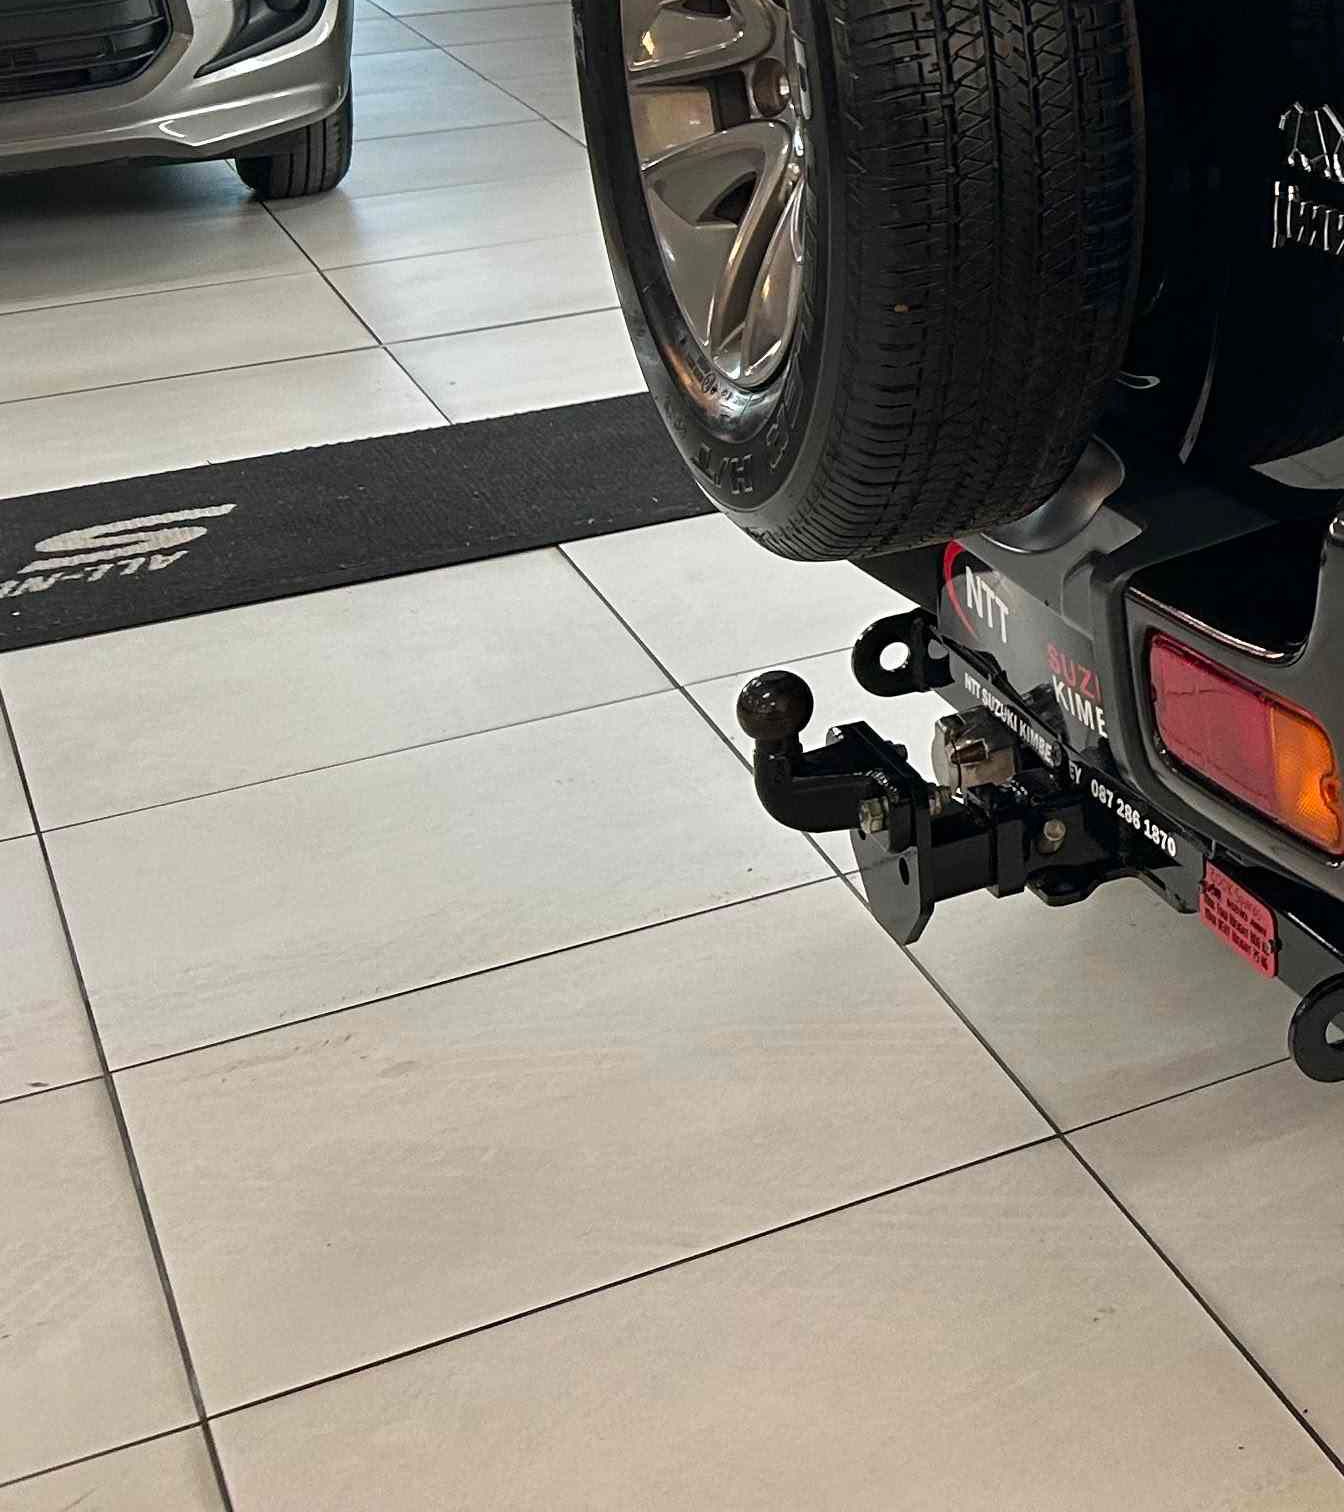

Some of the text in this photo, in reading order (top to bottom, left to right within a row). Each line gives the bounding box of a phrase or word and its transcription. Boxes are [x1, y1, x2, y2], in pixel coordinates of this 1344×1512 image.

[964, 565, 1010, 644] NTT
[964, 672, 981, 699] NTT
[981, 688, 1018, 733] SUZUKI
[1091, 779, 1114, 808] 087
[1144, 819, 1176, 857] 1870
